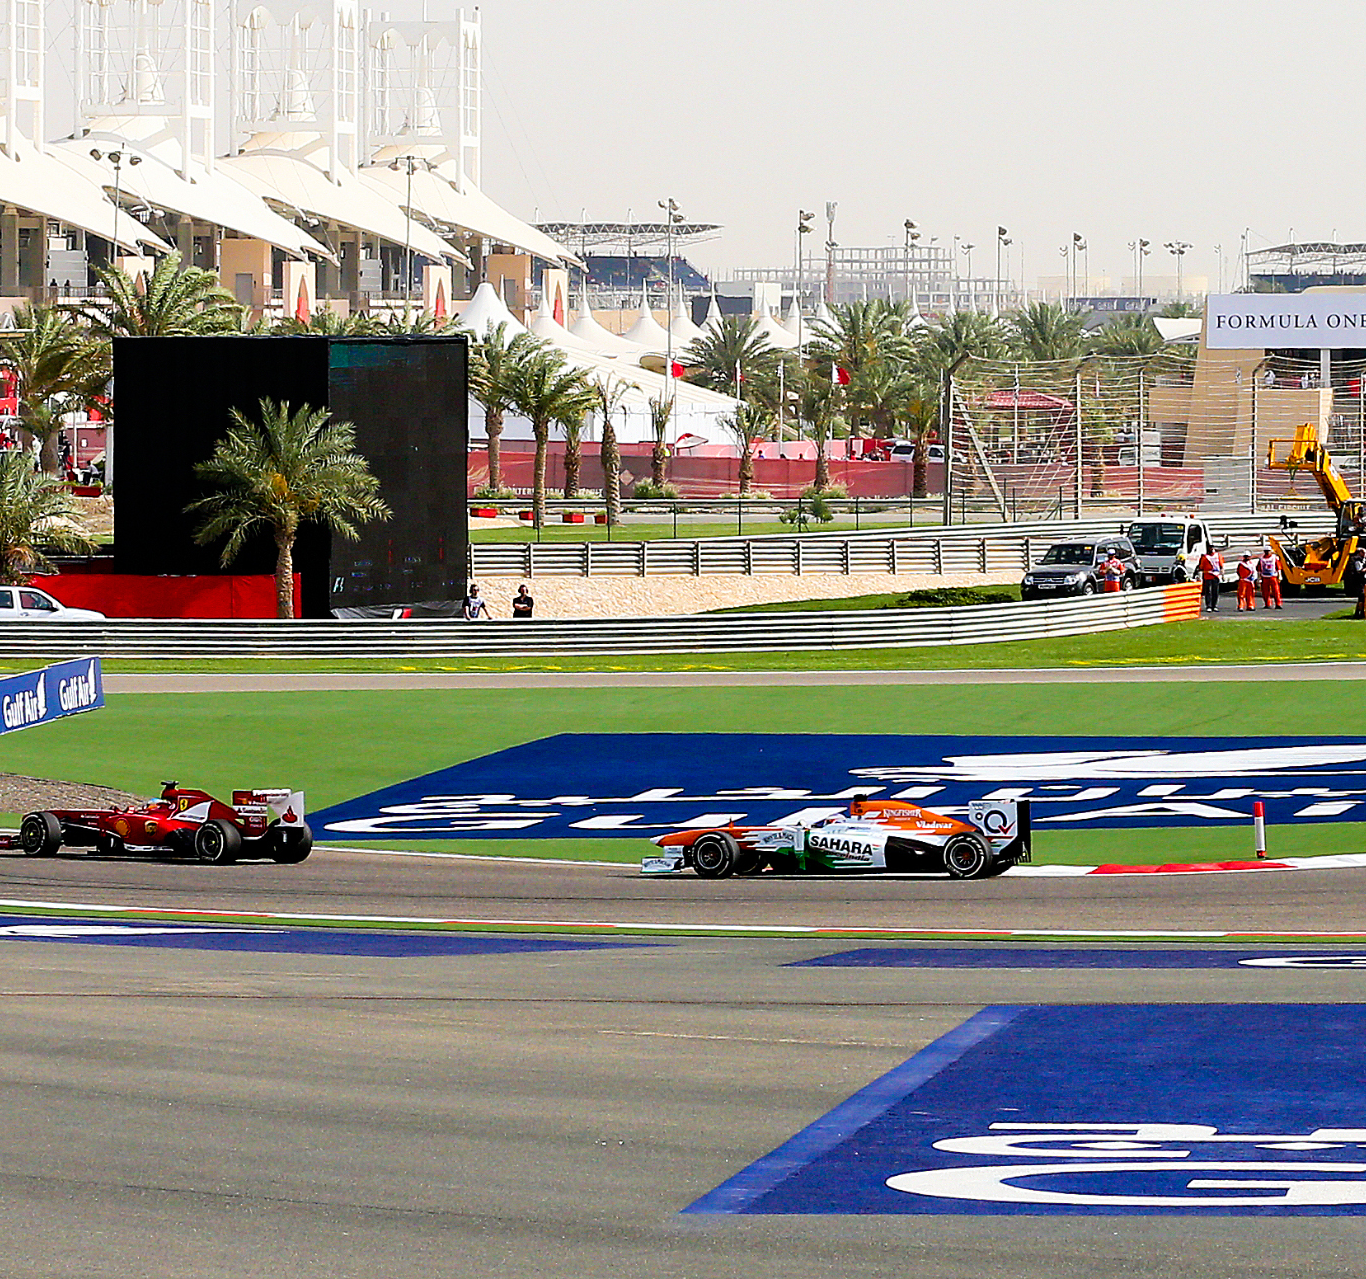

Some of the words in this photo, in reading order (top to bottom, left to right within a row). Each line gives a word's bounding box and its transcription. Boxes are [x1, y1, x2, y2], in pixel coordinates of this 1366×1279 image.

[1216, 313, 1318, 330] FORMULA
[59, 676, 78, 711] Gulf
[78, 675, 90, 707] Air
[3, 692, 24, 728] Gulf
[24, 690, 39, 723] Air
[322, 805, 970, 833] Gul
[883, 808, 922, 818] KINGFISHER
[916, 820, 953, 829] Vladivar
[810, 835, 873, 855] SAHARA
